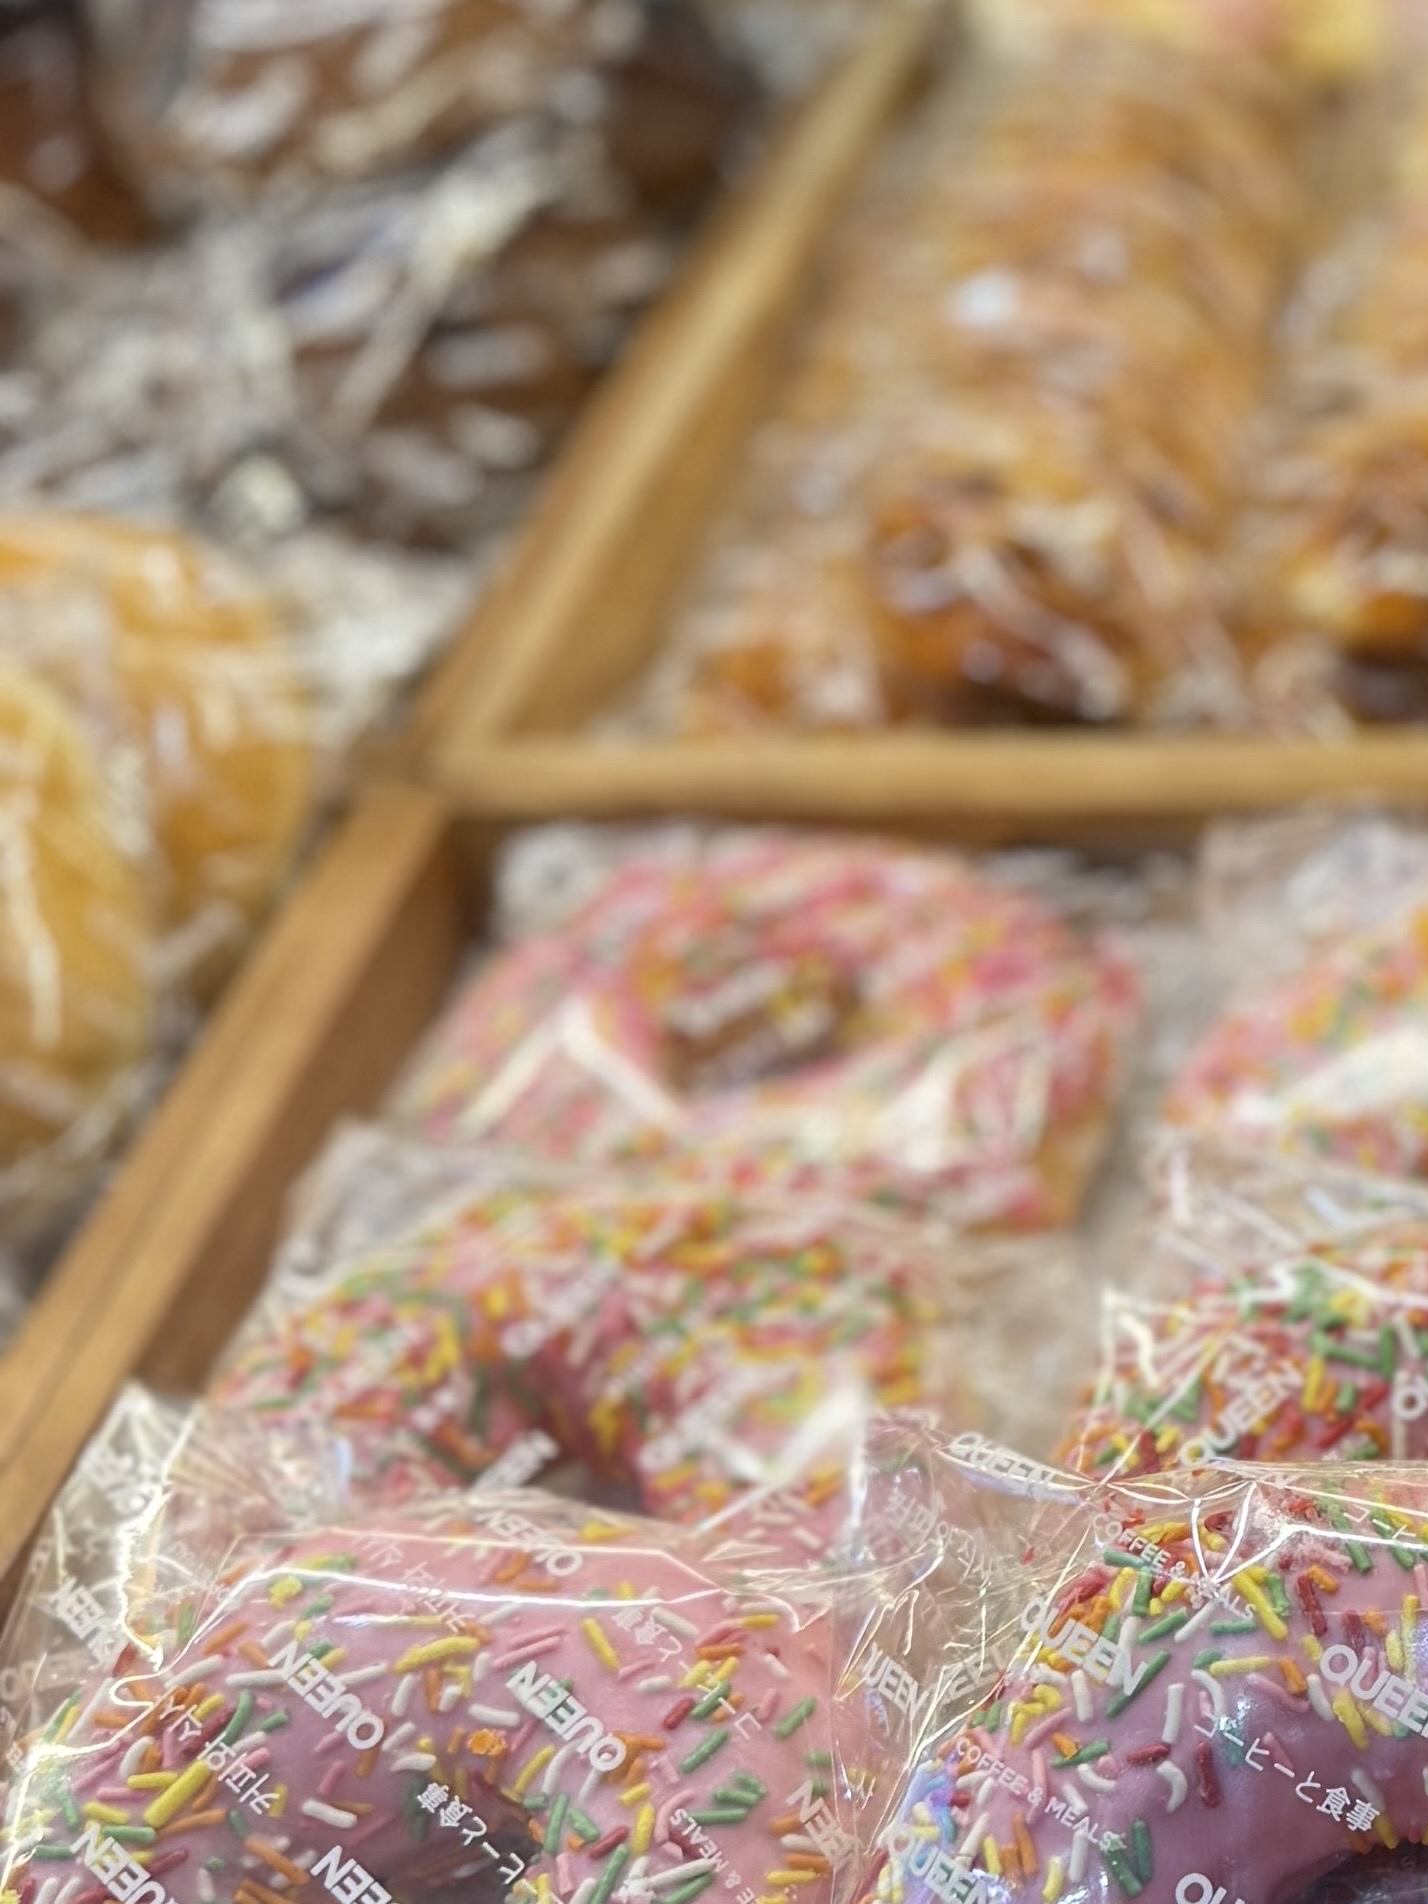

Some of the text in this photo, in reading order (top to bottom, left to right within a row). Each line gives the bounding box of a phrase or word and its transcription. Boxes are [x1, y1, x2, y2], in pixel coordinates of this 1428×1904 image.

[949, 1433, 1059, 1493] QUEEN
[1179, 1360, 1302, 1467] QUEEN
[476, 1510, 583, 1576] QUEEN
[268, 1640, 385, 1750] QUEEN
[1020, 1598, 1148, 1697] QUEEN
[506, 1661, 626, 1771] QUEEN
[198, 1732, 280, 1815] 커피와
[957, 1737, 1123, 1852] COFFEE & MEALS
[1195, 1715, 1379, 1832] コーヒーと食事
[670, 1808, 729, 1875] MEALS
[724, 1869, 742, 1888] &
